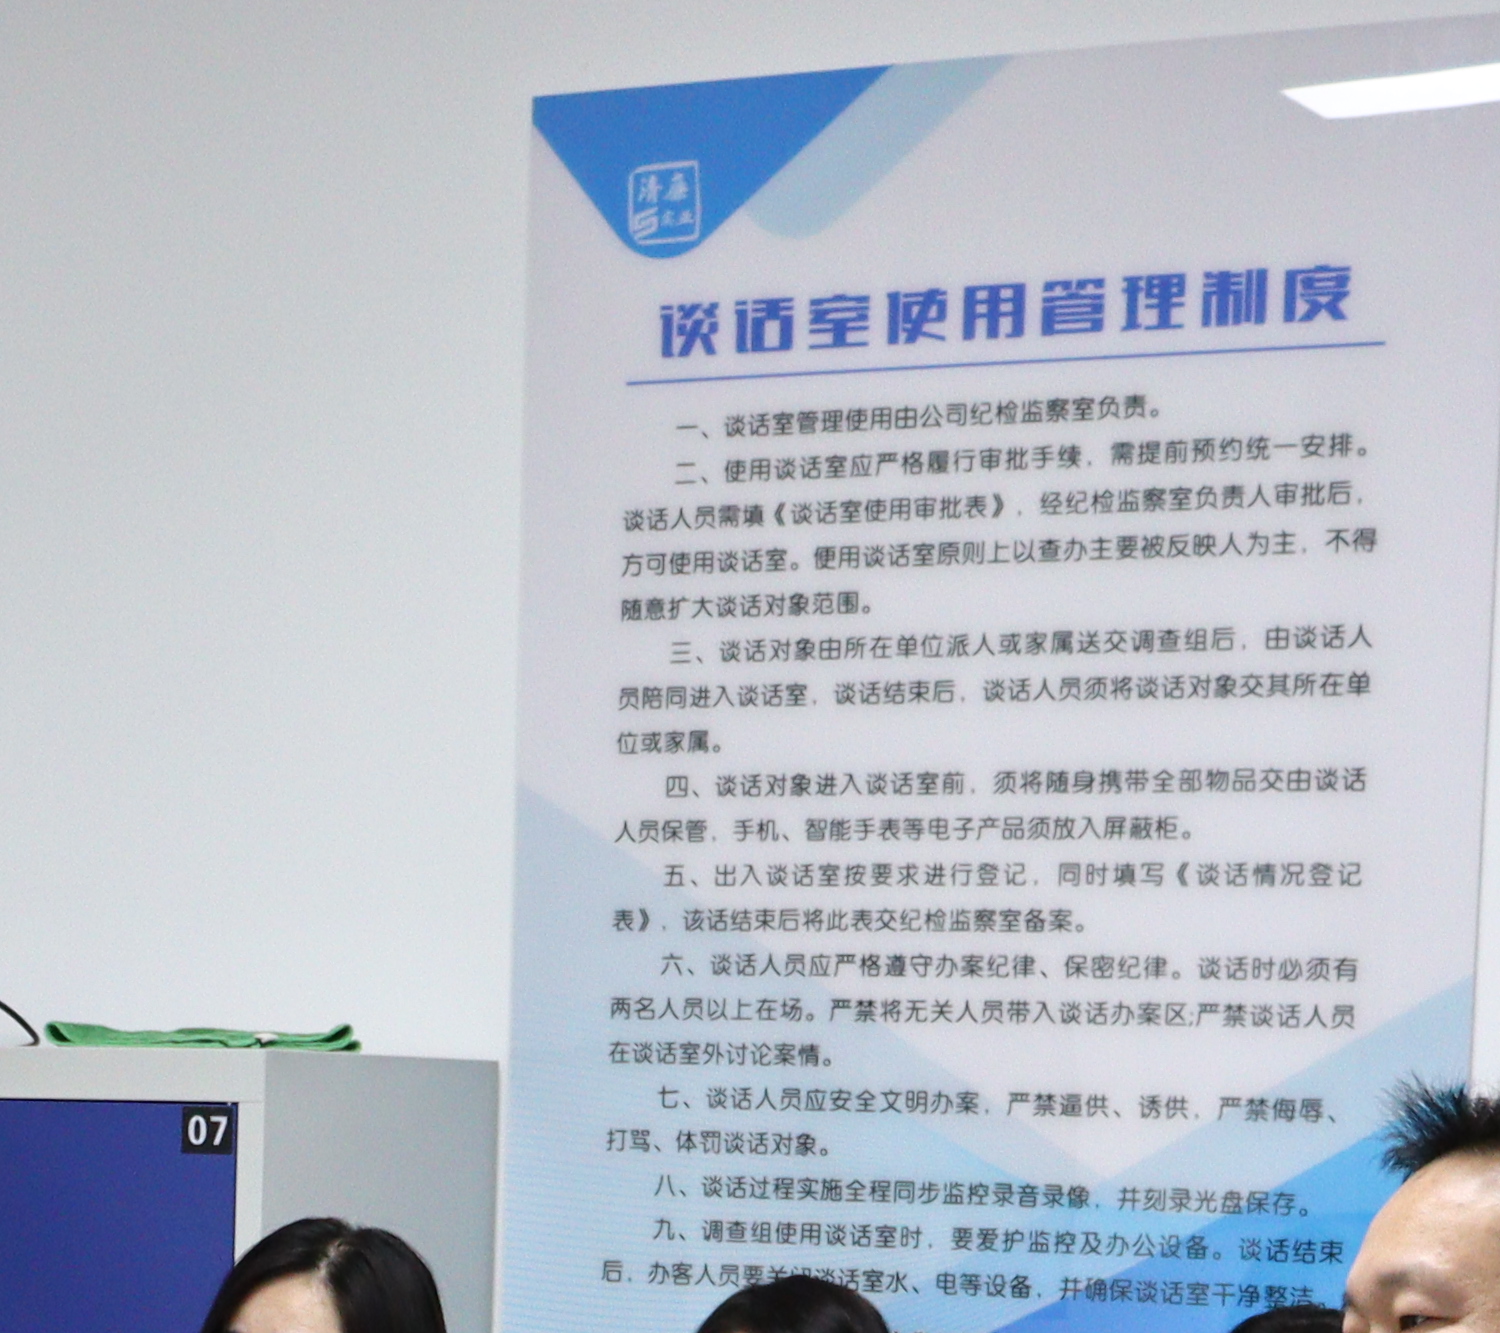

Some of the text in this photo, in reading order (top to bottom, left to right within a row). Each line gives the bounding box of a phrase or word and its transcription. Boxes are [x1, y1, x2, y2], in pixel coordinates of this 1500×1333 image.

[660, 265, 1351, 358] 谈话室使用管理制度
[676, 394, 1159, 439] 一、谈话室管理使用由公司纪检监察室负责。
[621, 591, 870, 622] 随意扩大谈话对象范围。
[616, 730, 721, 755] 位或家属。
[608, 1041, 831, 1067] 在谈话室外讨论案情。
[187, 1114, 229, 1146] 07
[606, 1128, 828, 1156] 打骂、体罚谈话对象。
